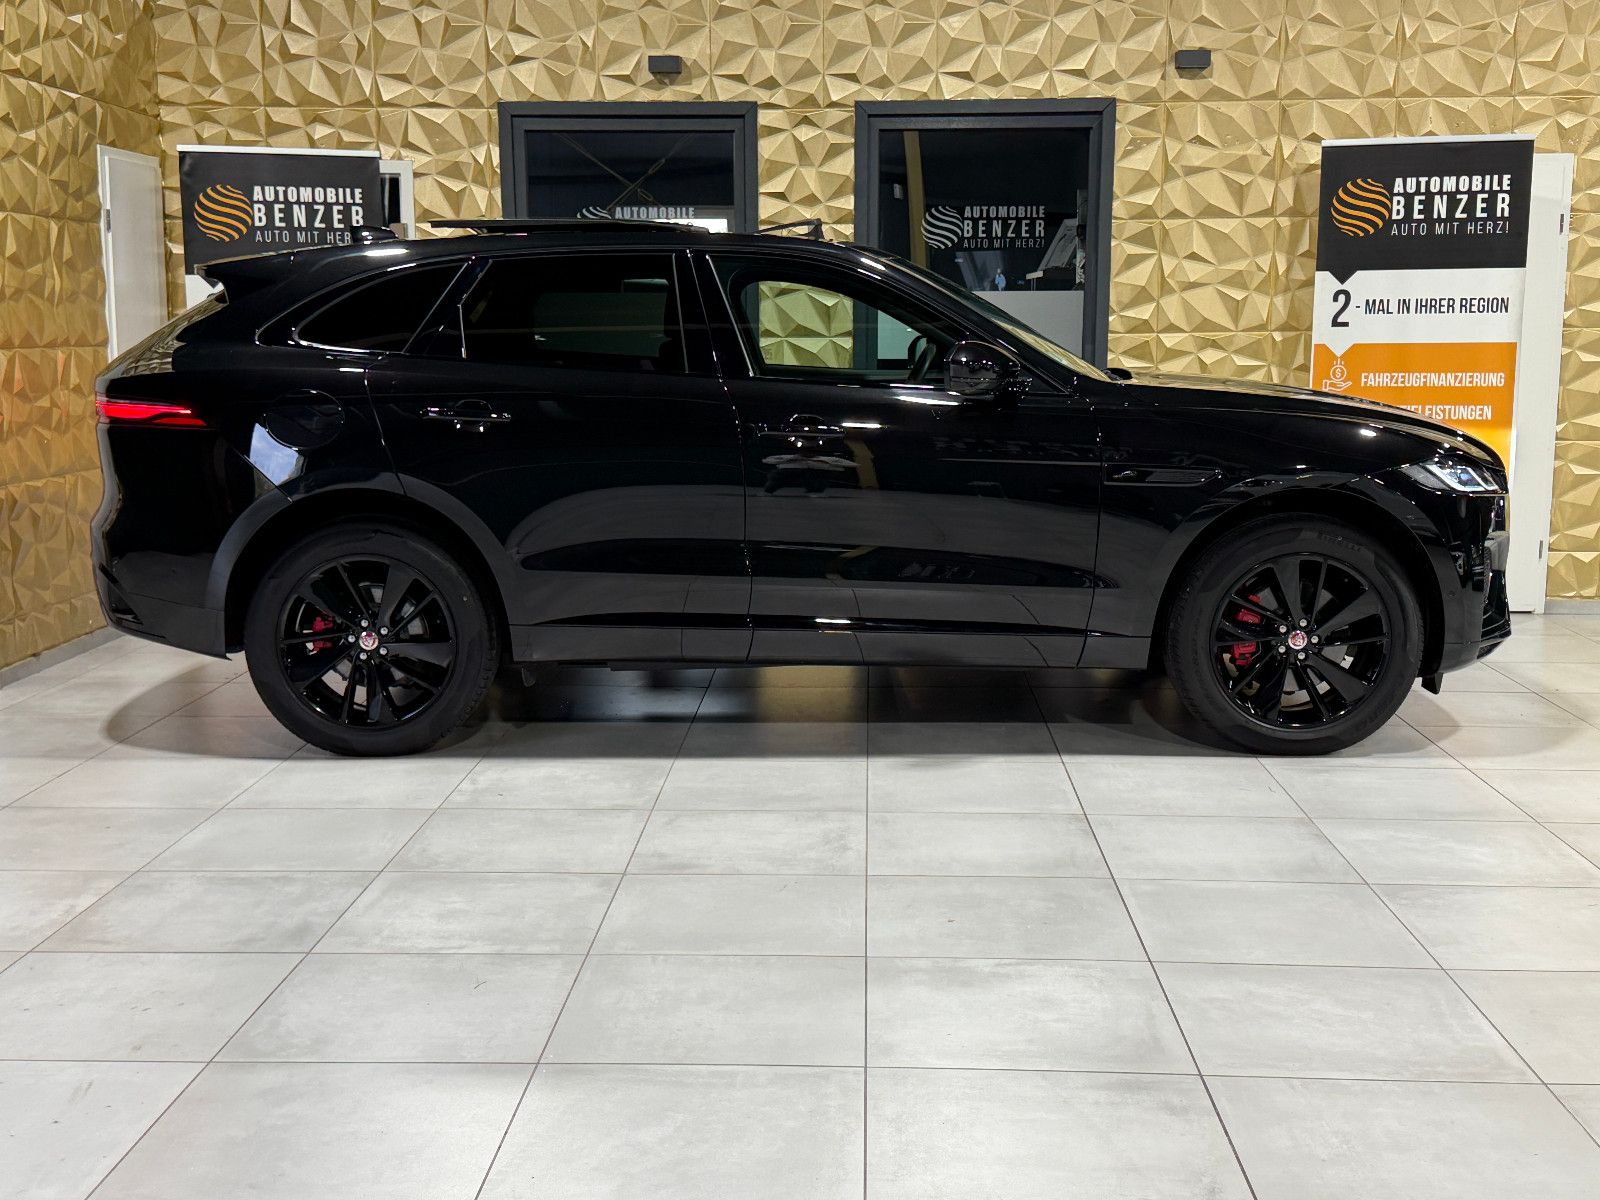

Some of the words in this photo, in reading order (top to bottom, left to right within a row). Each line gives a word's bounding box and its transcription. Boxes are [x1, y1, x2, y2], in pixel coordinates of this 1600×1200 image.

[1393, 174, 1512, 194] AUTOMOBILE
[253, 185, 363, 204] AUTOMOBILE
[614, 206, 695, 220] AUTOMOBILE
[963, 205, 1046, 218] AUTOMOBILE
[1391, 192, 1510, 220] BENZER
[253, 203, 364, 229] BENZER
[963, 219, 1046, 238] BENZER
[1390, 222, 1427, 236] AUTO
[1435, 221, 1460, 235] MIT
[1467, 220, 1509, 235] HERZ!
[255, 230, 290, 243] AUTO
[297, 230, 320, 244] MIT
[326, 231, 352, 245] HER
[963, 238, 989, 249] AUTO
[993, 238, 1010, 249] MIT
[1015, 238, 1046, 249] HERZ!
[1330, 288, 1352, 328] 2
[1364, 298, 1394, 315] MAL
[1397, 298, 1411, 315] IN
[1414, 297, 1456, 315] IHRER
[1459, 297, 1510, 314] REGION
[1360, 372, 1506, 388] FAHRZEUGFINANZIERUNG
